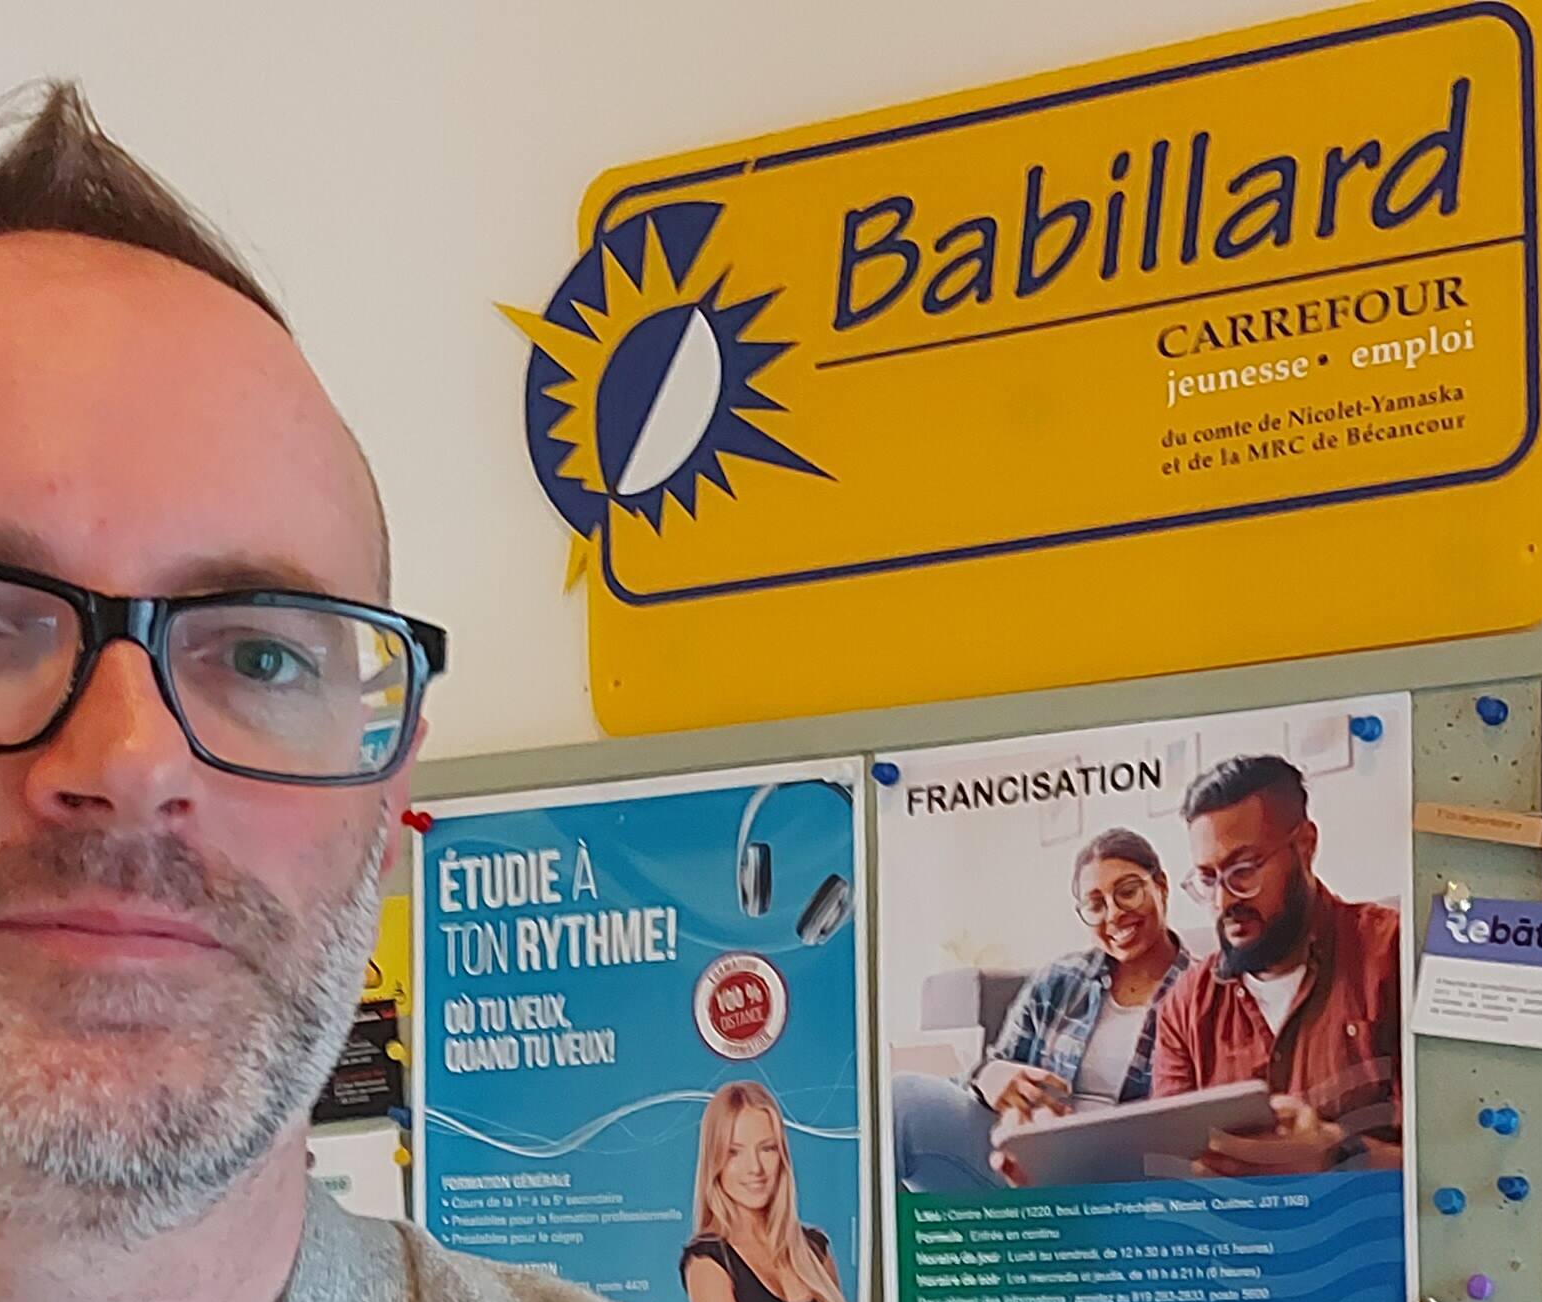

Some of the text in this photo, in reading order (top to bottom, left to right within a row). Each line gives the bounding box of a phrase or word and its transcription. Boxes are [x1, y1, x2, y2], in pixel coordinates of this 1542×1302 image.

[832, 77, 1470, 332] Babillard
[1156, 276, 1468, 358] CARREFOUR
[1166, 320, 1475, 407] jeunesse emploi
[1162, 428, 1187, 449] du
[1258, 411, 1281, 433] de
[1288, 385, 1465, 429] Nicolet-Yamaska
[1162, 415, 1466, 476] et de la MRC de Bécancour
[908, 758, 1161, 816] FRANCISATION
[438, 838, 598, 913] ÉTUDIE À
[439, 905, 677, 977] TON RYTHME!
[444, 991, 573, 1034] OÙ TU VEUX,
[444, 1028, 615, 1073] QUAND TU VEUX!
